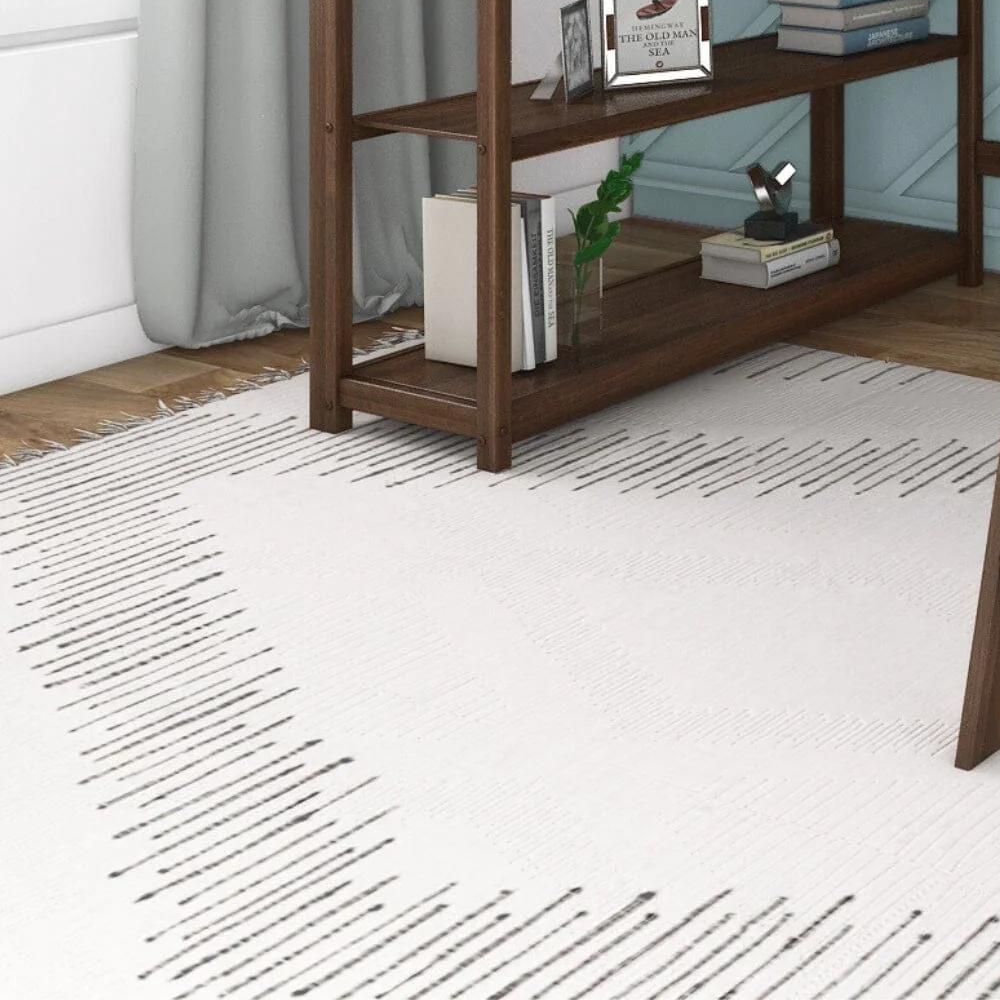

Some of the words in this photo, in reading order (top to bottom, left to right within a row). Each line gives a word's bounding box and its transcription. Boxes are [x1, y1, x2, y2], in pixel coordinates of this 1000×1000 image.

[632, 22, 684, 31] HEMINGWAY
[619, 34, 643, 43] THE
[645, 31, 670, 41] OLD
[672, 29, 697, 39] MAN
[648, 48, 670, 57] SEA
